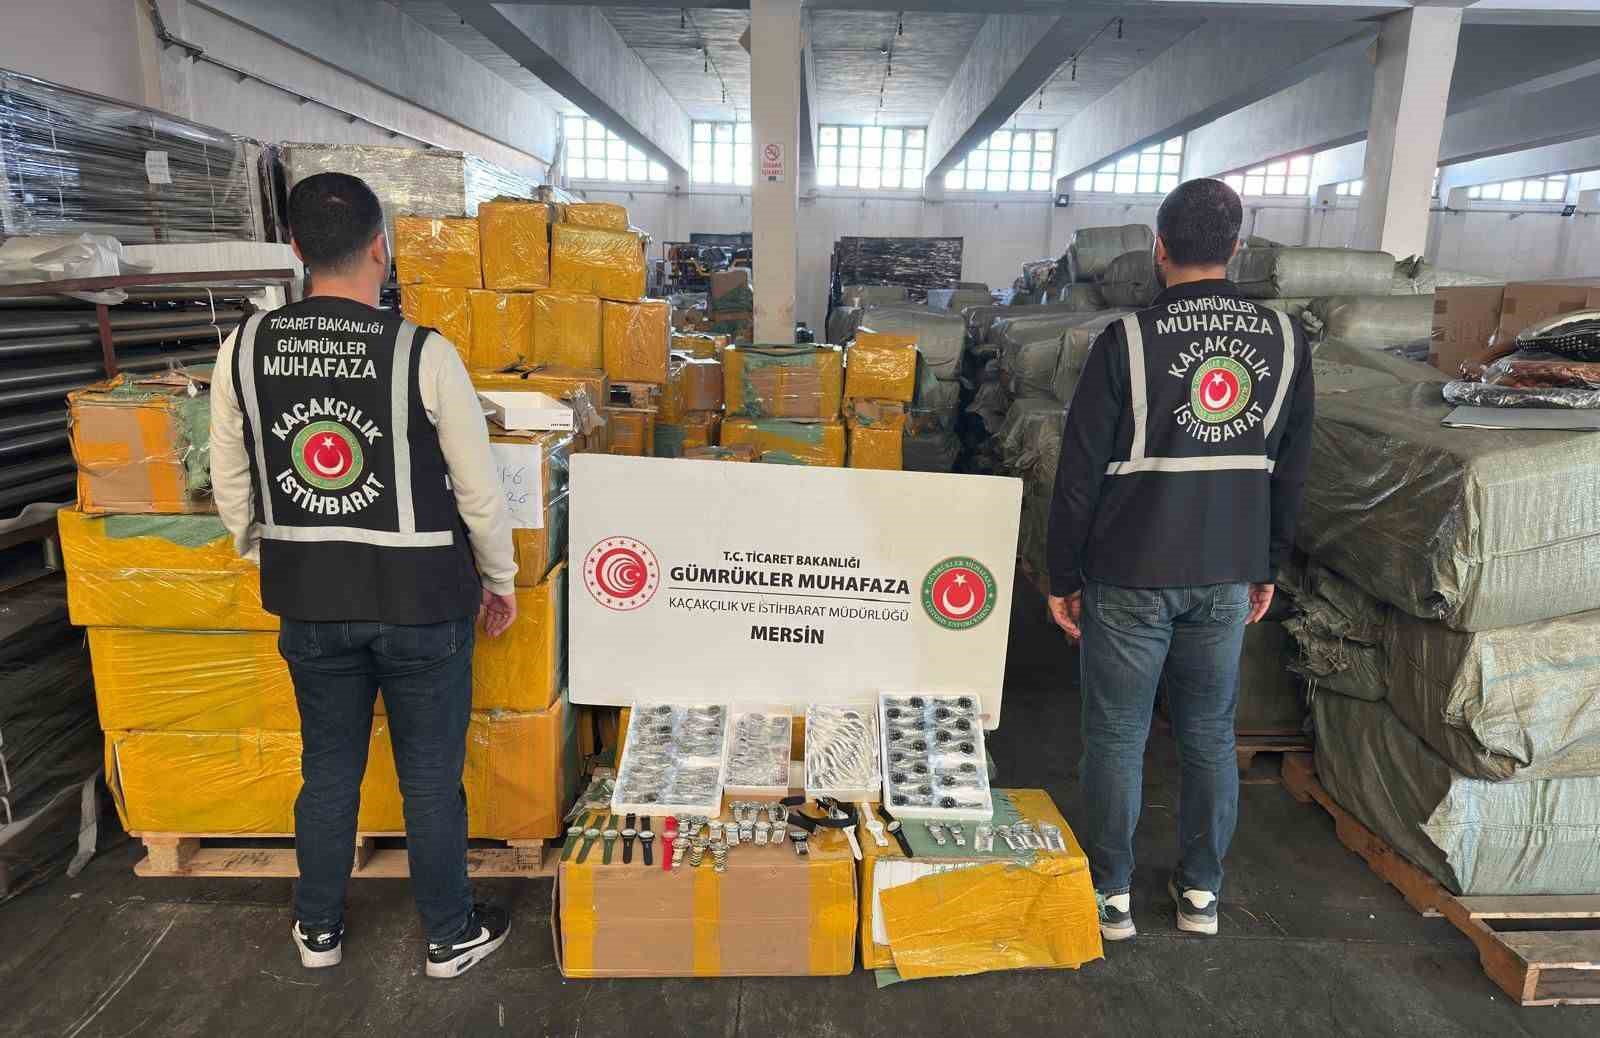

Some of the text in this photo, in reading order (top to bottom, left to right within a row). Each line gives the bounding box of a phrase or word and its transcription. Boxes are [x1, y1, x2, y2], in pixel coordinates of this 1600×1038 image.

[1168, 295, 1257, 314] GÜMRÜKLER
[270, 315, 316, 330] TİCARET
[1156, 314, 1274, 335] MUHAFAZA
[277, 336, 367, 355] GÜMRÜKLER
[263, 355, 377, 379] MUHAFAZA
[1168, 336, 1271, 381] KAÇAKÇILIK
[271, 397, 384, 446] KAÇAKÇILIK
[1173, 401, 1264, 443] İSTİHBARAT
[276, 468, 385, 515] İSTİHBARAT
[723, 550, 860, 569] T.C. TİCARET BAKANLIĞI
[670, 563, 910, 595] GÜMRÜKLER MUHAFAZA
[669, 596, 909, 622] KAÇAKÇILIK VE İSTİHBARAT MÜDÜRLÜĞÜ
[750, 624, 825, 645] MERSİN
